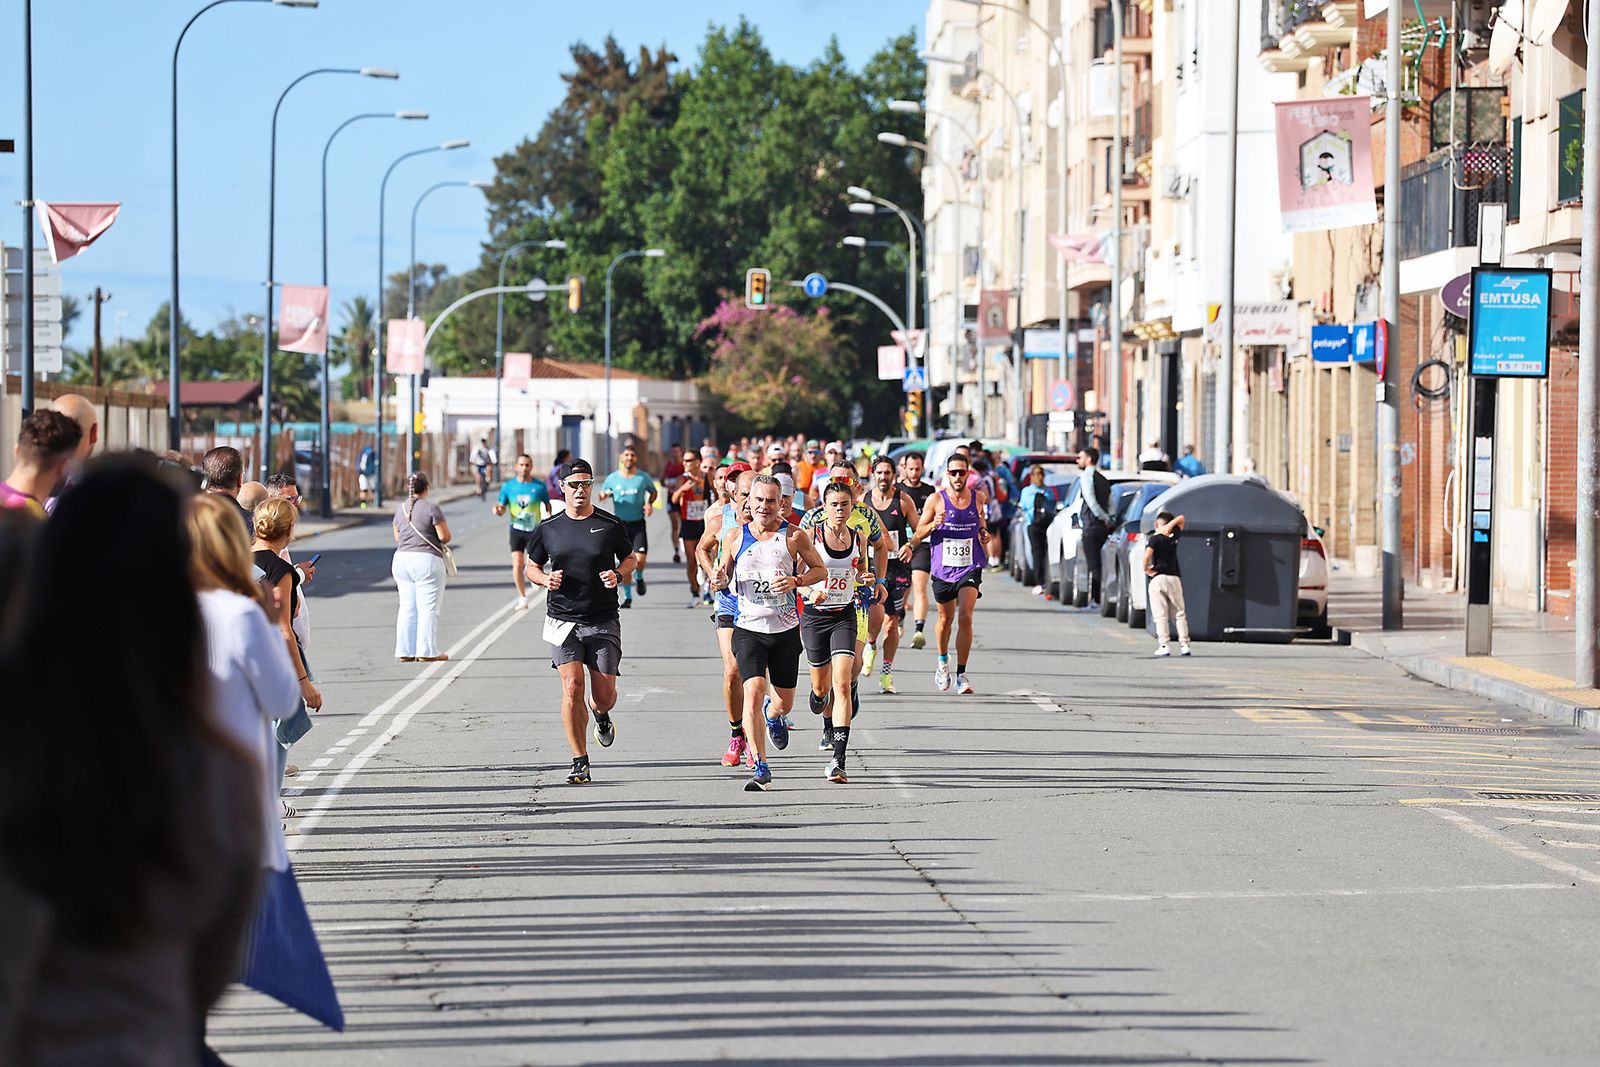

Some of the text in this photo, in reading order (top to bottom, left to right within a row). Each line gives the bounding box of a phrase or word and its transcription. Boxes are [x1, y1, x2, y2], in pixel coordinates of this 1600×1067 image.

[1479, 292, 1541, 304] EMTUSA
[946, 546, 971, 557] 1339
[824, 577, 848, 591] 126
